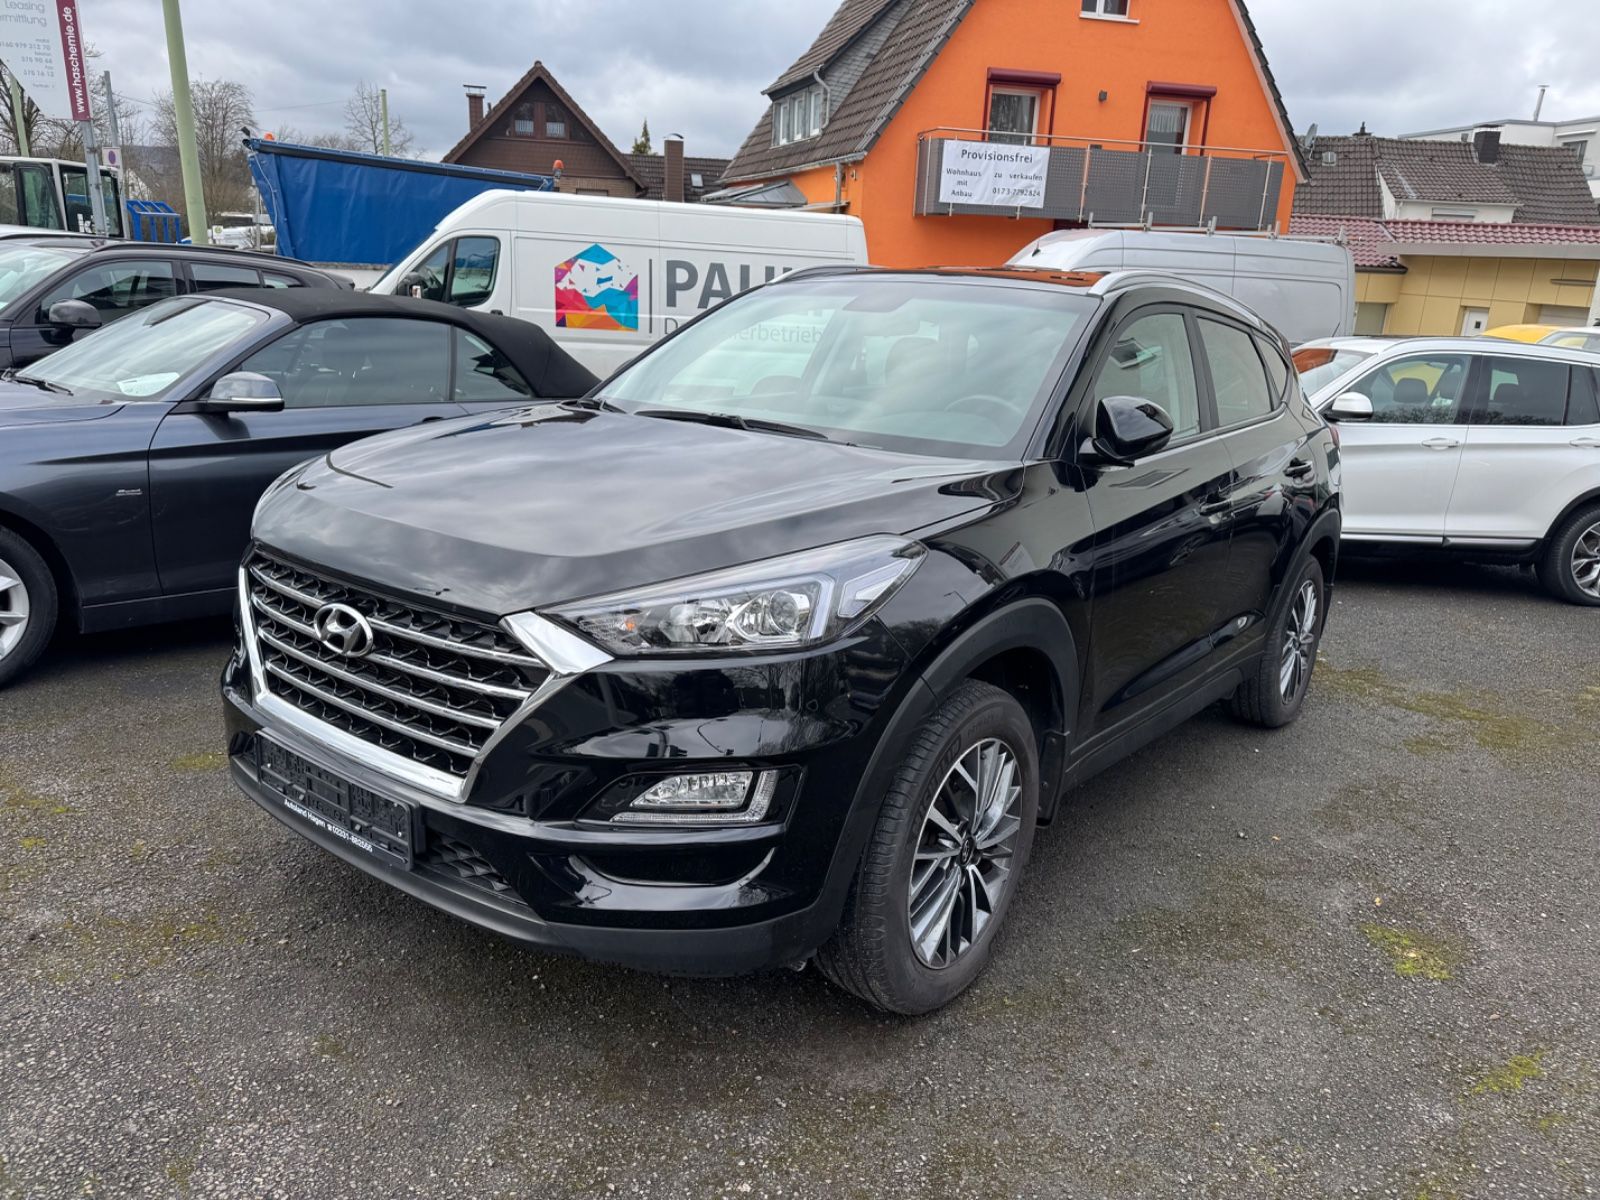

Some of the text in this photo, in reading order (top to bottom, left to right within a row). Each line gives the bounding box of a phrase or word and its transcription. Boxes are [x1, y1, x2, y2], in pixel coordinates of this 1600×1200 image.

[961, 149, 1033, 164] Provisionsfrei
[946, 168, 982, 177] Wohnhaus
[1009, 172, 1043, 181] verkaufen
[956, 179, 968, 187] mit
[950, 189, 973, 198] Anbau
